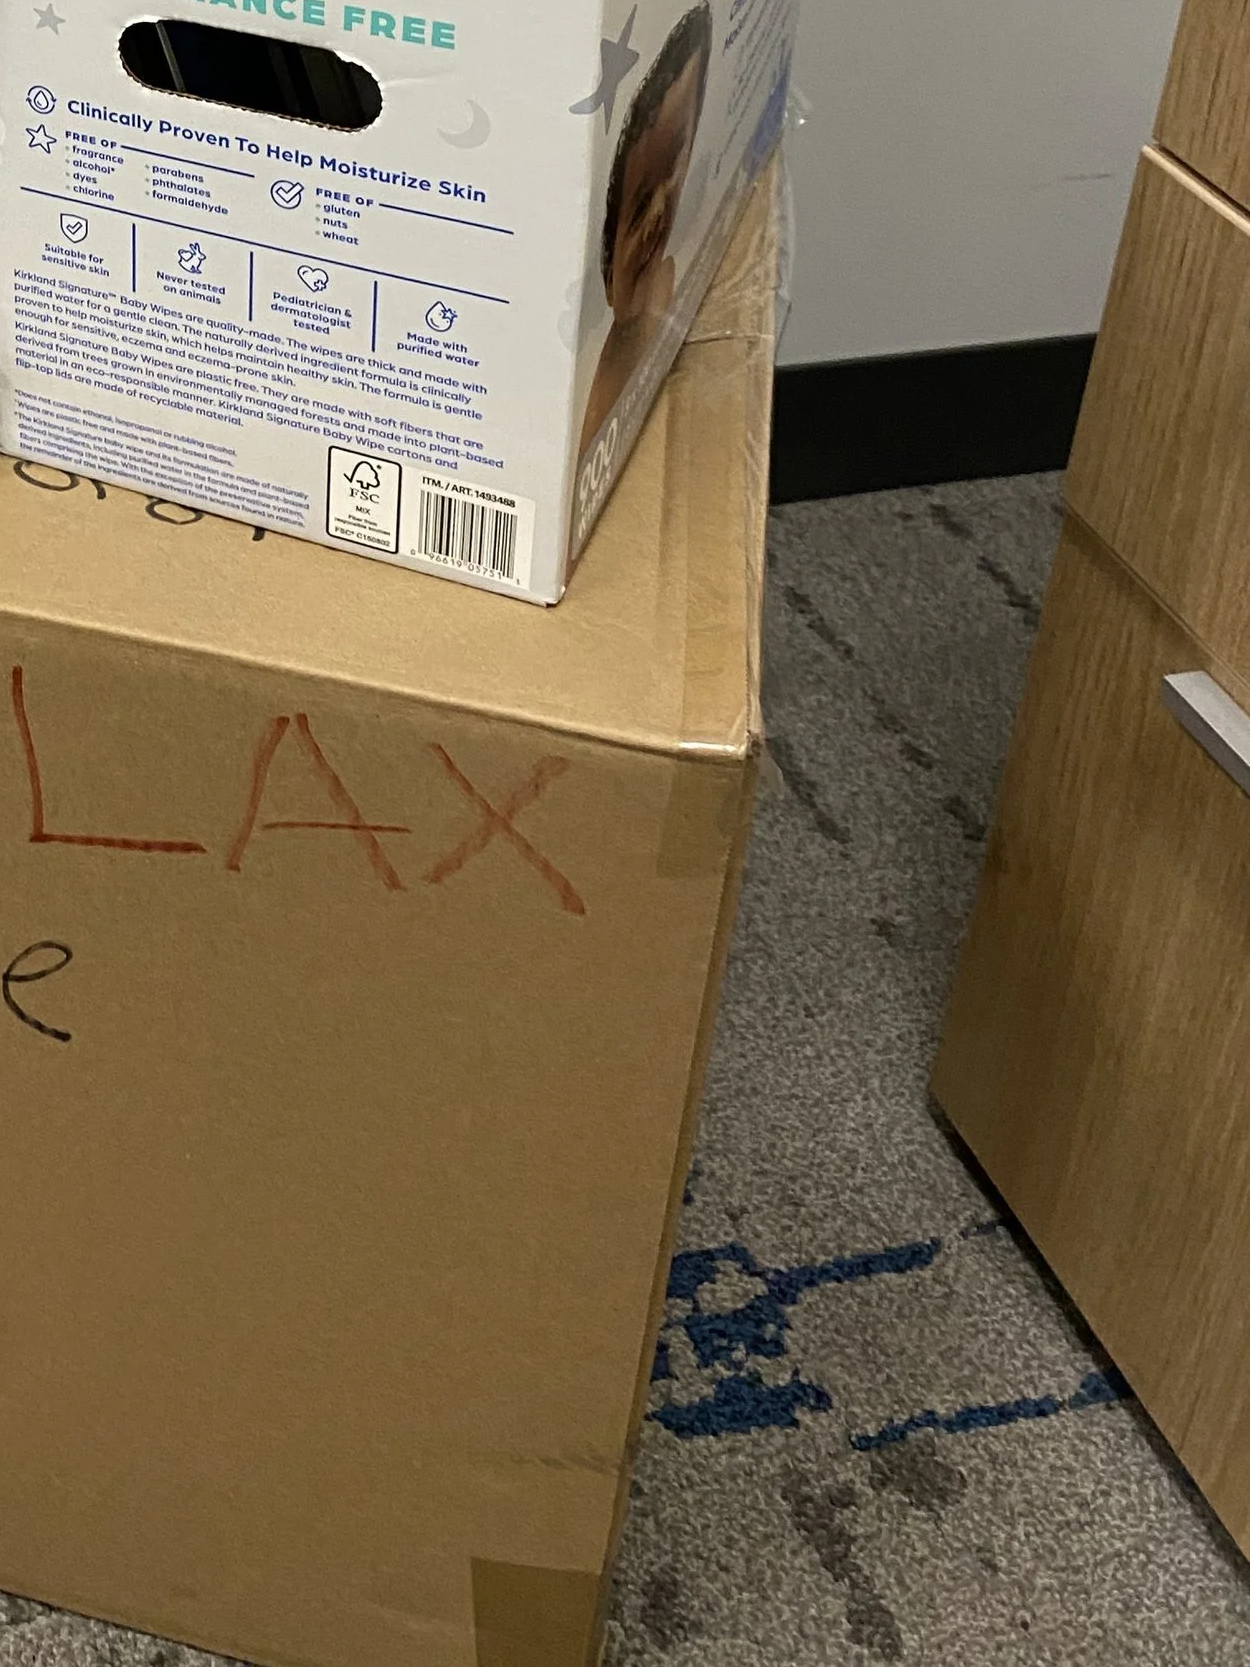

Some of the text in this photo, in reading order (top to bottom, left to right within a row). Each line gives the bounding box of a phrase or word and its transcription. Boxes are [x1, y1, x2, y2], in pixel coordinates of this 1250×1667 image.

[343, 6, 457, 49] FREE
[65, 130, 117, 149] FREE OF
[68, 100, 485, 203] Clinically Proven To Help Moisturize Skin
[73, 145, 124, 165] fragrance
[73, 172, 97, 184] dyes
[152, 166, 204, 183] parabens
[73, 185, 114, 201] chlorine
[152, 179, 211, 198] phthalates
[316, 187, 374, 207] FREE OF
[152, 190, 228, 215] formaldehyde
[324, 204, 360, 218] gluten
[323, 218, 348, 229] nuts
[323, 231, 358, 245] wheat
[45, 243, 104, 264] Suitable for
[42, 255, 109, 277] sensitive skin
[157, 271, 225, 295] Never tested
[163, 285, 221, 305] on animals
[273, 291, 352, 318] Pediatrician &
[271, 303, 351, 329] dermatologist
[14, 269, 487, 395] Kirkland Signature™ Baby Wipes are quality-made. The wipes are thick and made with
[293, 319, 330, 335] tested
[14, 283, 52, 298] purified
[55, 293, 85, 307] water
[87, 299, 102, 310] for
[113, 308, 146, 322] gentle
[149, 317, 180, 331] clean.
[182, 324, 202, 337] The
[205, 332, 253, 351] naturally
[256, 344, 298, 361] derived
[301, 353, 359, 376] ingredient
[361, 369, 407, 388] formula
[410, 380, 418, 391] is
[421, 386, 471, 405] clinically
[15, 308, 296, 387] enough for sensitive, eczema and eczema-prone skin.
[407, 332, 467, 353] Made with
[15, 295, 483, 420] proven to help moisturize skin, which helps maintain healthy skin. The formula is gentle
[397, 342, 479, 367] purified water
[15, 321, 483, 450] Kirkland Signature Baby Wipes are plastic free. They are made with soft fibers that are
[15, 335, 503, 469] derived from trees grown in environmentally managed forests and made into plant-based
[349, 487, 380, 504] FSC
[422, 476, 516, 508] ITM. / ART. 1493488
[355, 505, 371, 515] MIX
[12, 665, 586, 916] LAX
